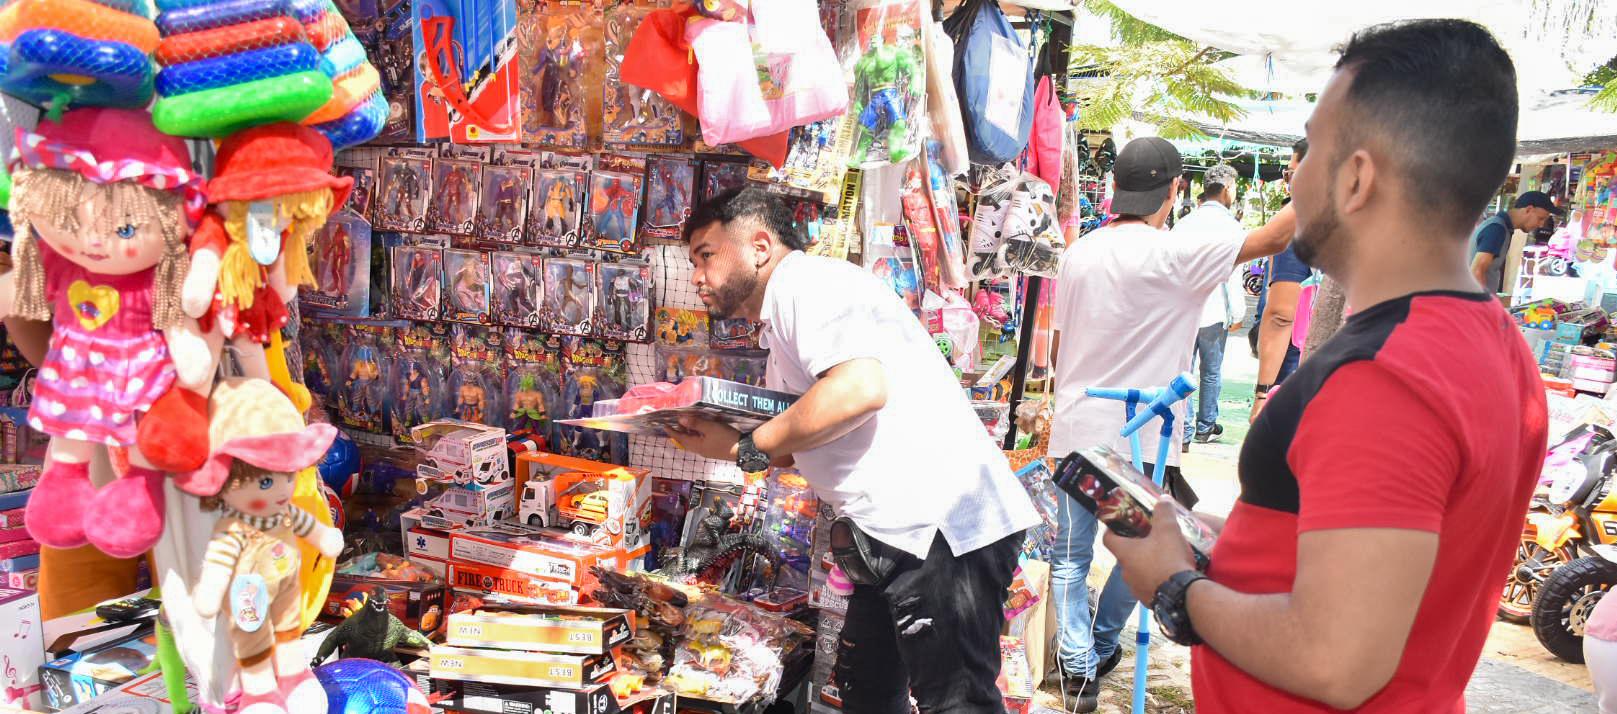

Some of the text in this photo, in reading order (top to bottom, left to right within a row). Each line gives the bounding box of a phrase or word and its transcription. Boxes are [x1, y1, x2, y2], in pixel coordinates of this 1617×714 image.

[752, 396, 774, 411] THEM
[457, 571, 523, 594] FIRE TRUCK
[569, 633, 592, 641] BEST
[549, 668, 572, 677] BEST
